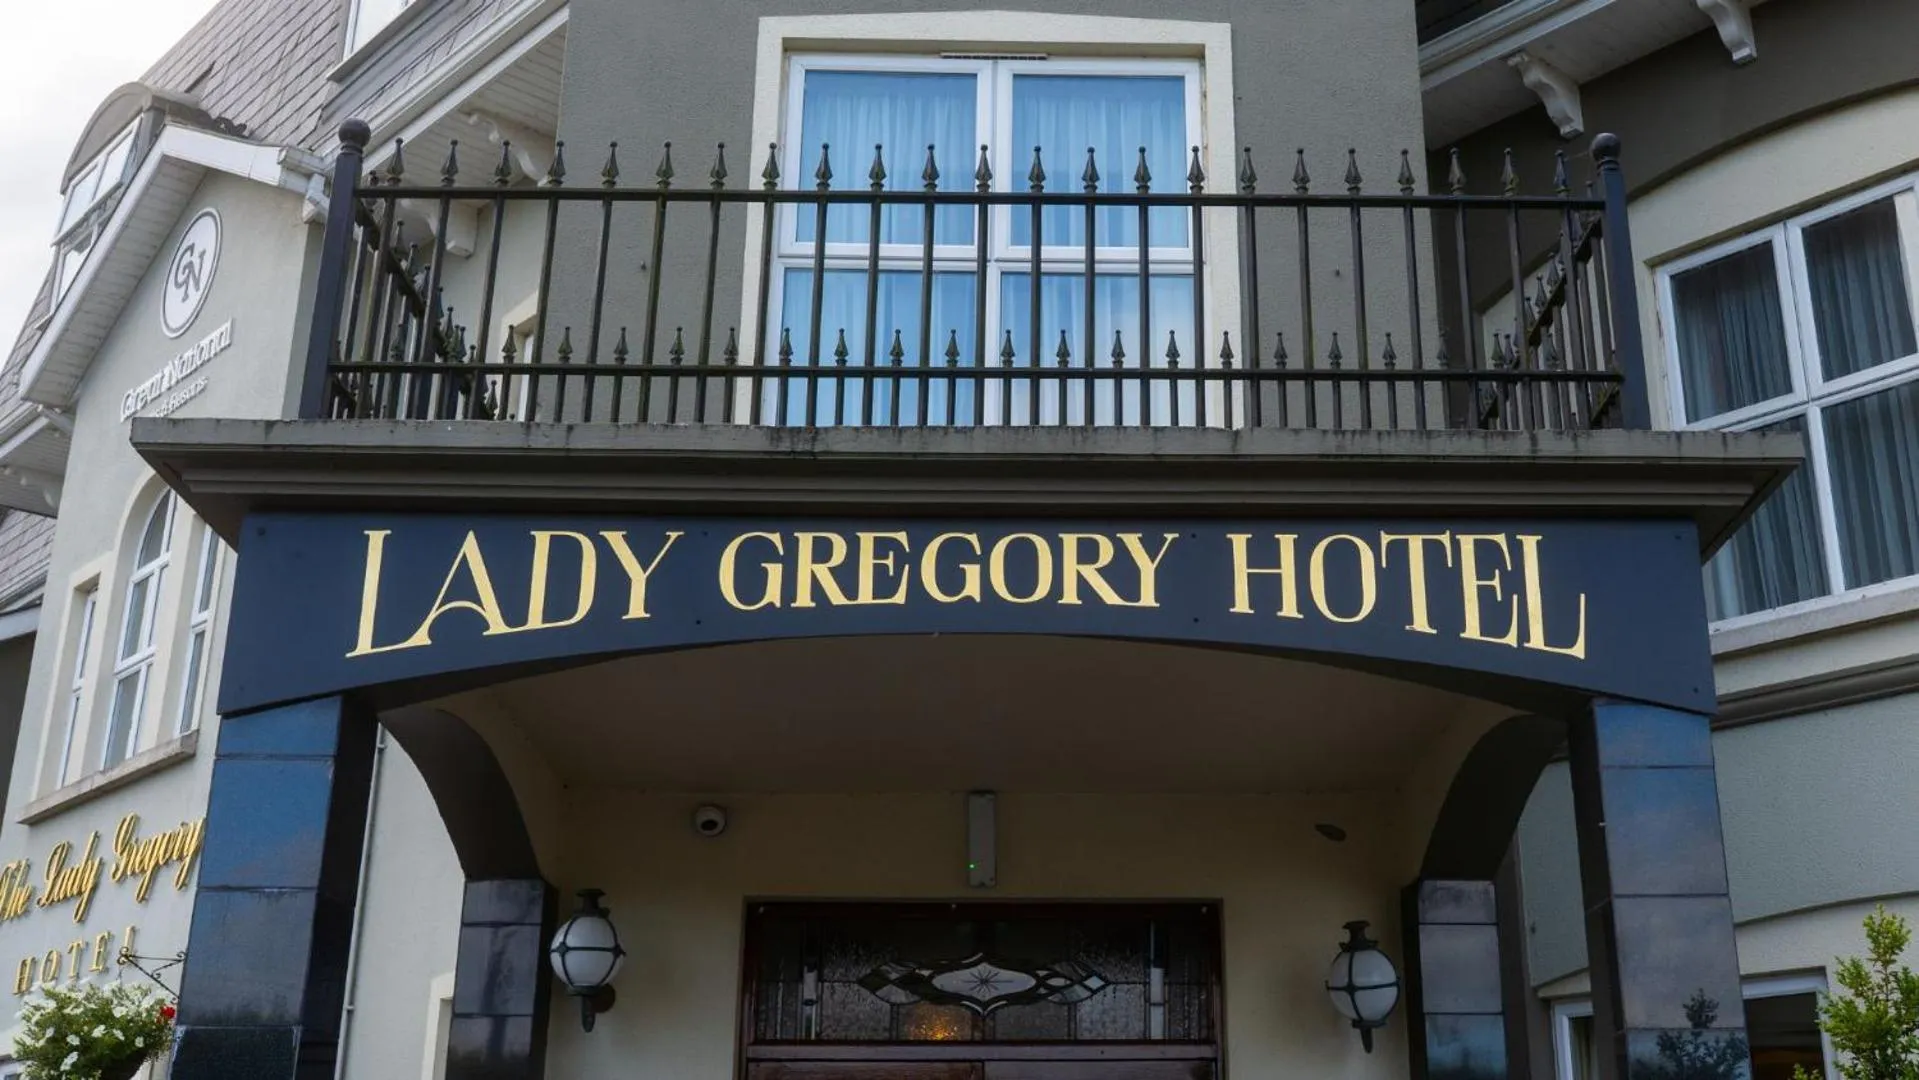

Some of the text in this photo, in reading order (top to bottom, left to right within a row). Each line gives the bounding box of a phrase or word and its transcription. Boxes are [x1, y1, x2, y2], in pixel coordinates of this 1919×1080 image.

[346, 530, 1586, 660] LADY GREGORY HOTEL
[36, 830, 104, 924] Lady
[111, 812, 206, 903] Gregory
